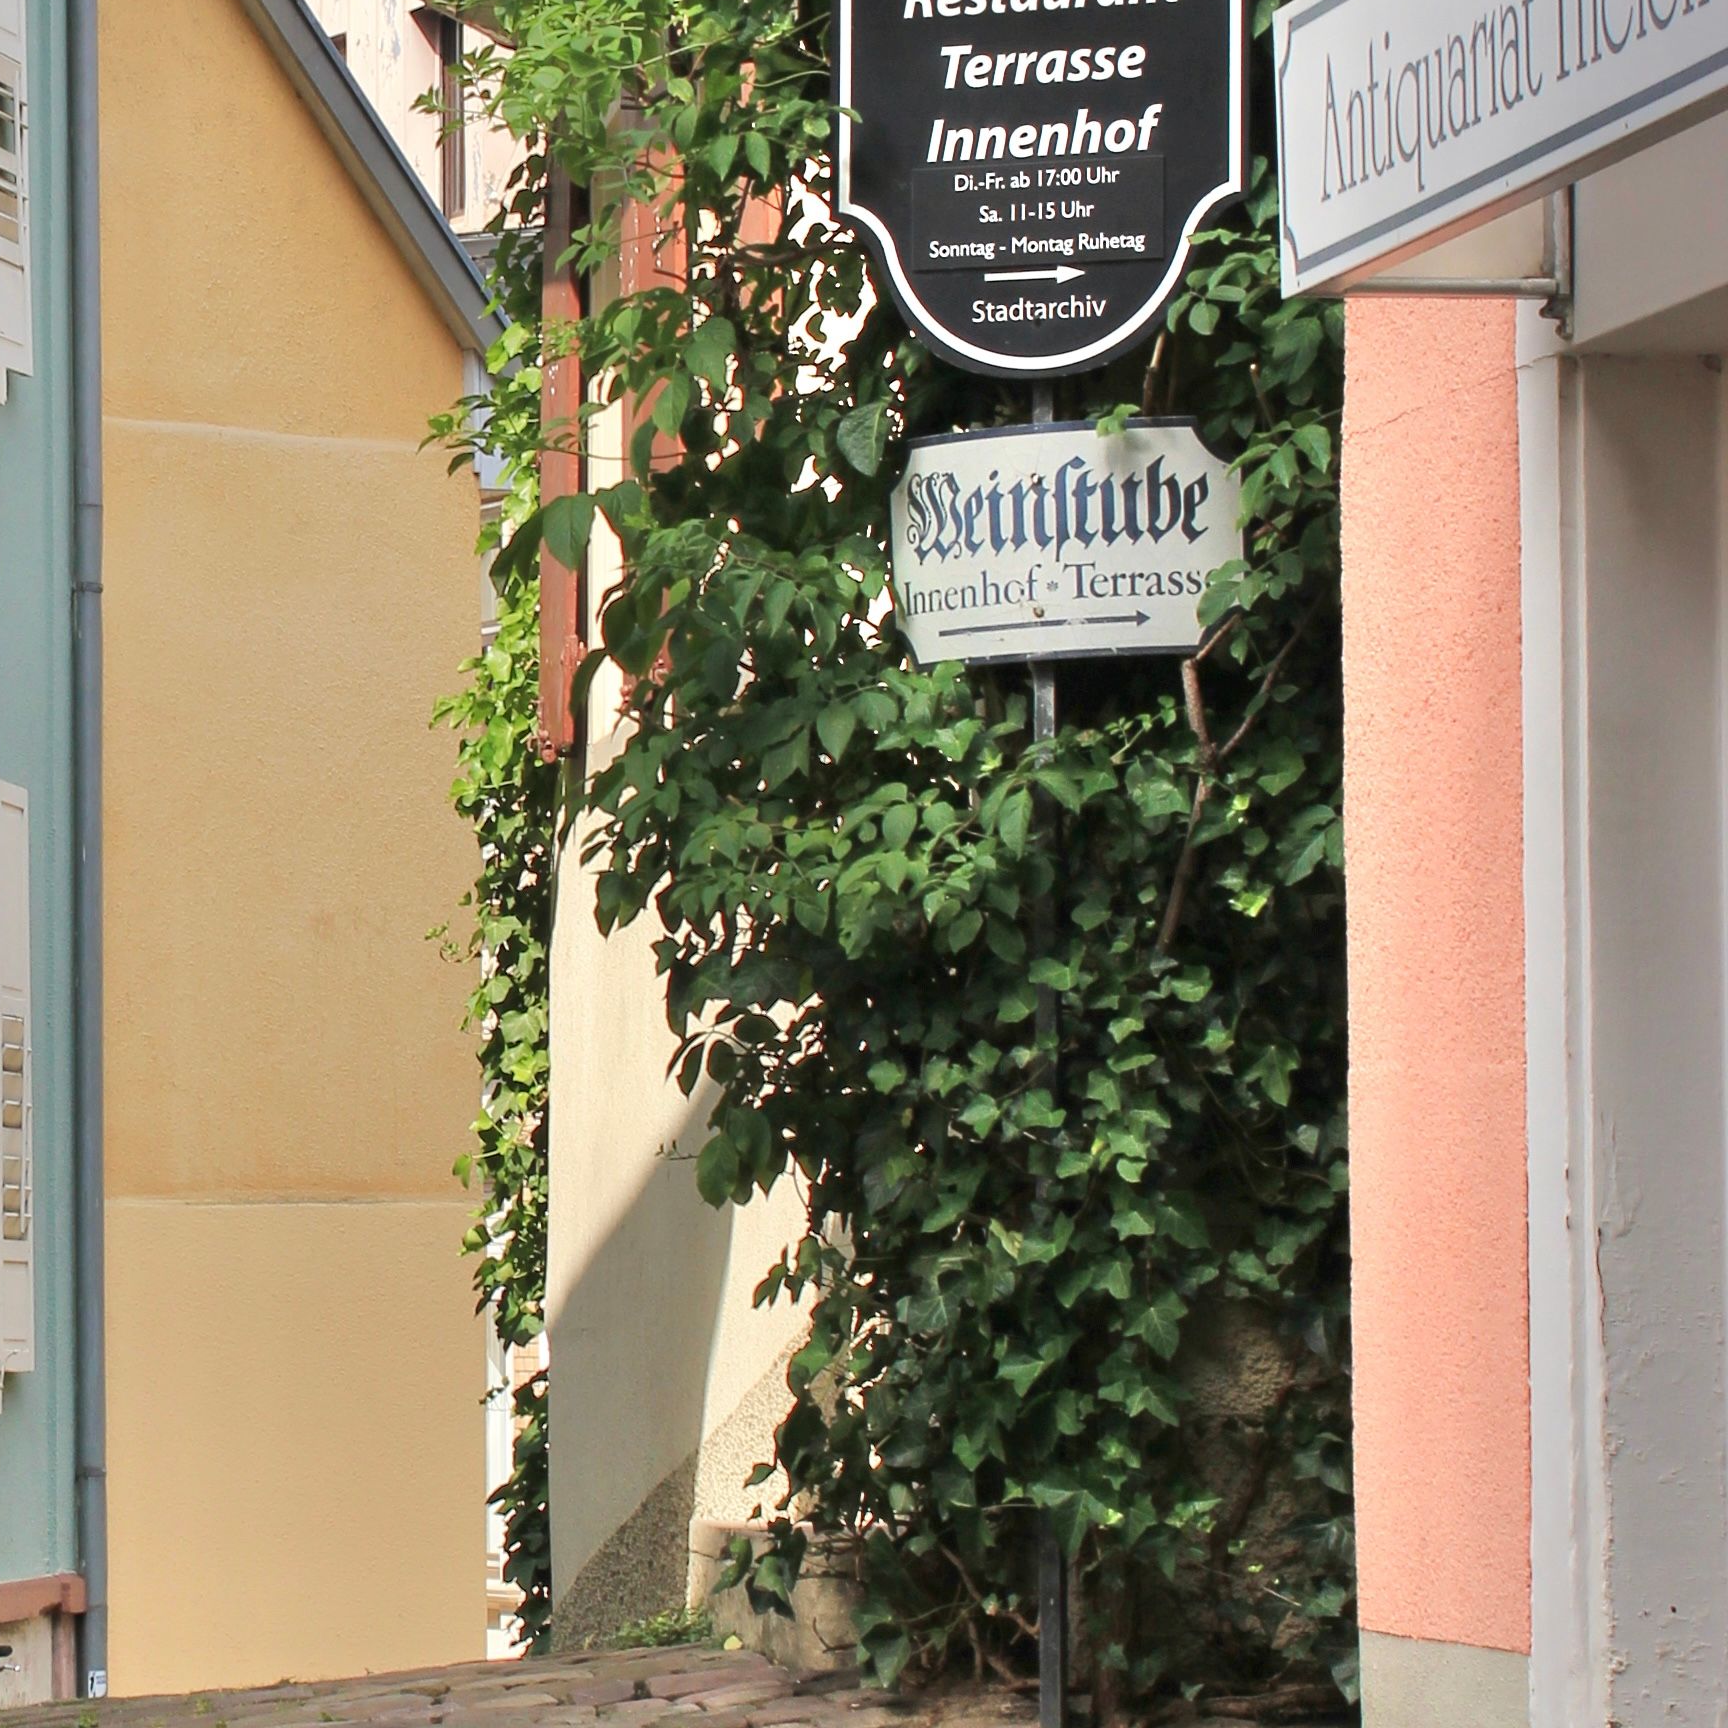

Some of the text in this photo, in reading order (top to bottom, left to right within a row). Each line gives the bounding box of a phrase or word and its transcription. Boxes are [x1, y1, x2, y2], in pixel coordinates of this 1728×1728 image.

[940, 44, 1146, 89] Terrasse
[927, 103, 1163, 163] Innenhof
[954, 166, 1120, 192] Di.-Fr. ab 17:00 Uhr
[978, 201, 1095, 223] Sa. 11-15 Uhr
[929, 240, 995, 260] Sonntag
[1011, 235, 1074, 255] Montag
[1078, 232, 1145, 252] Ruhetag
[972, 294, 1107, 323] Stadtarchiv
[906, 454, 1210, 565] Weinstube
[904, 561, 1213, 616] Innenhof Terrass
